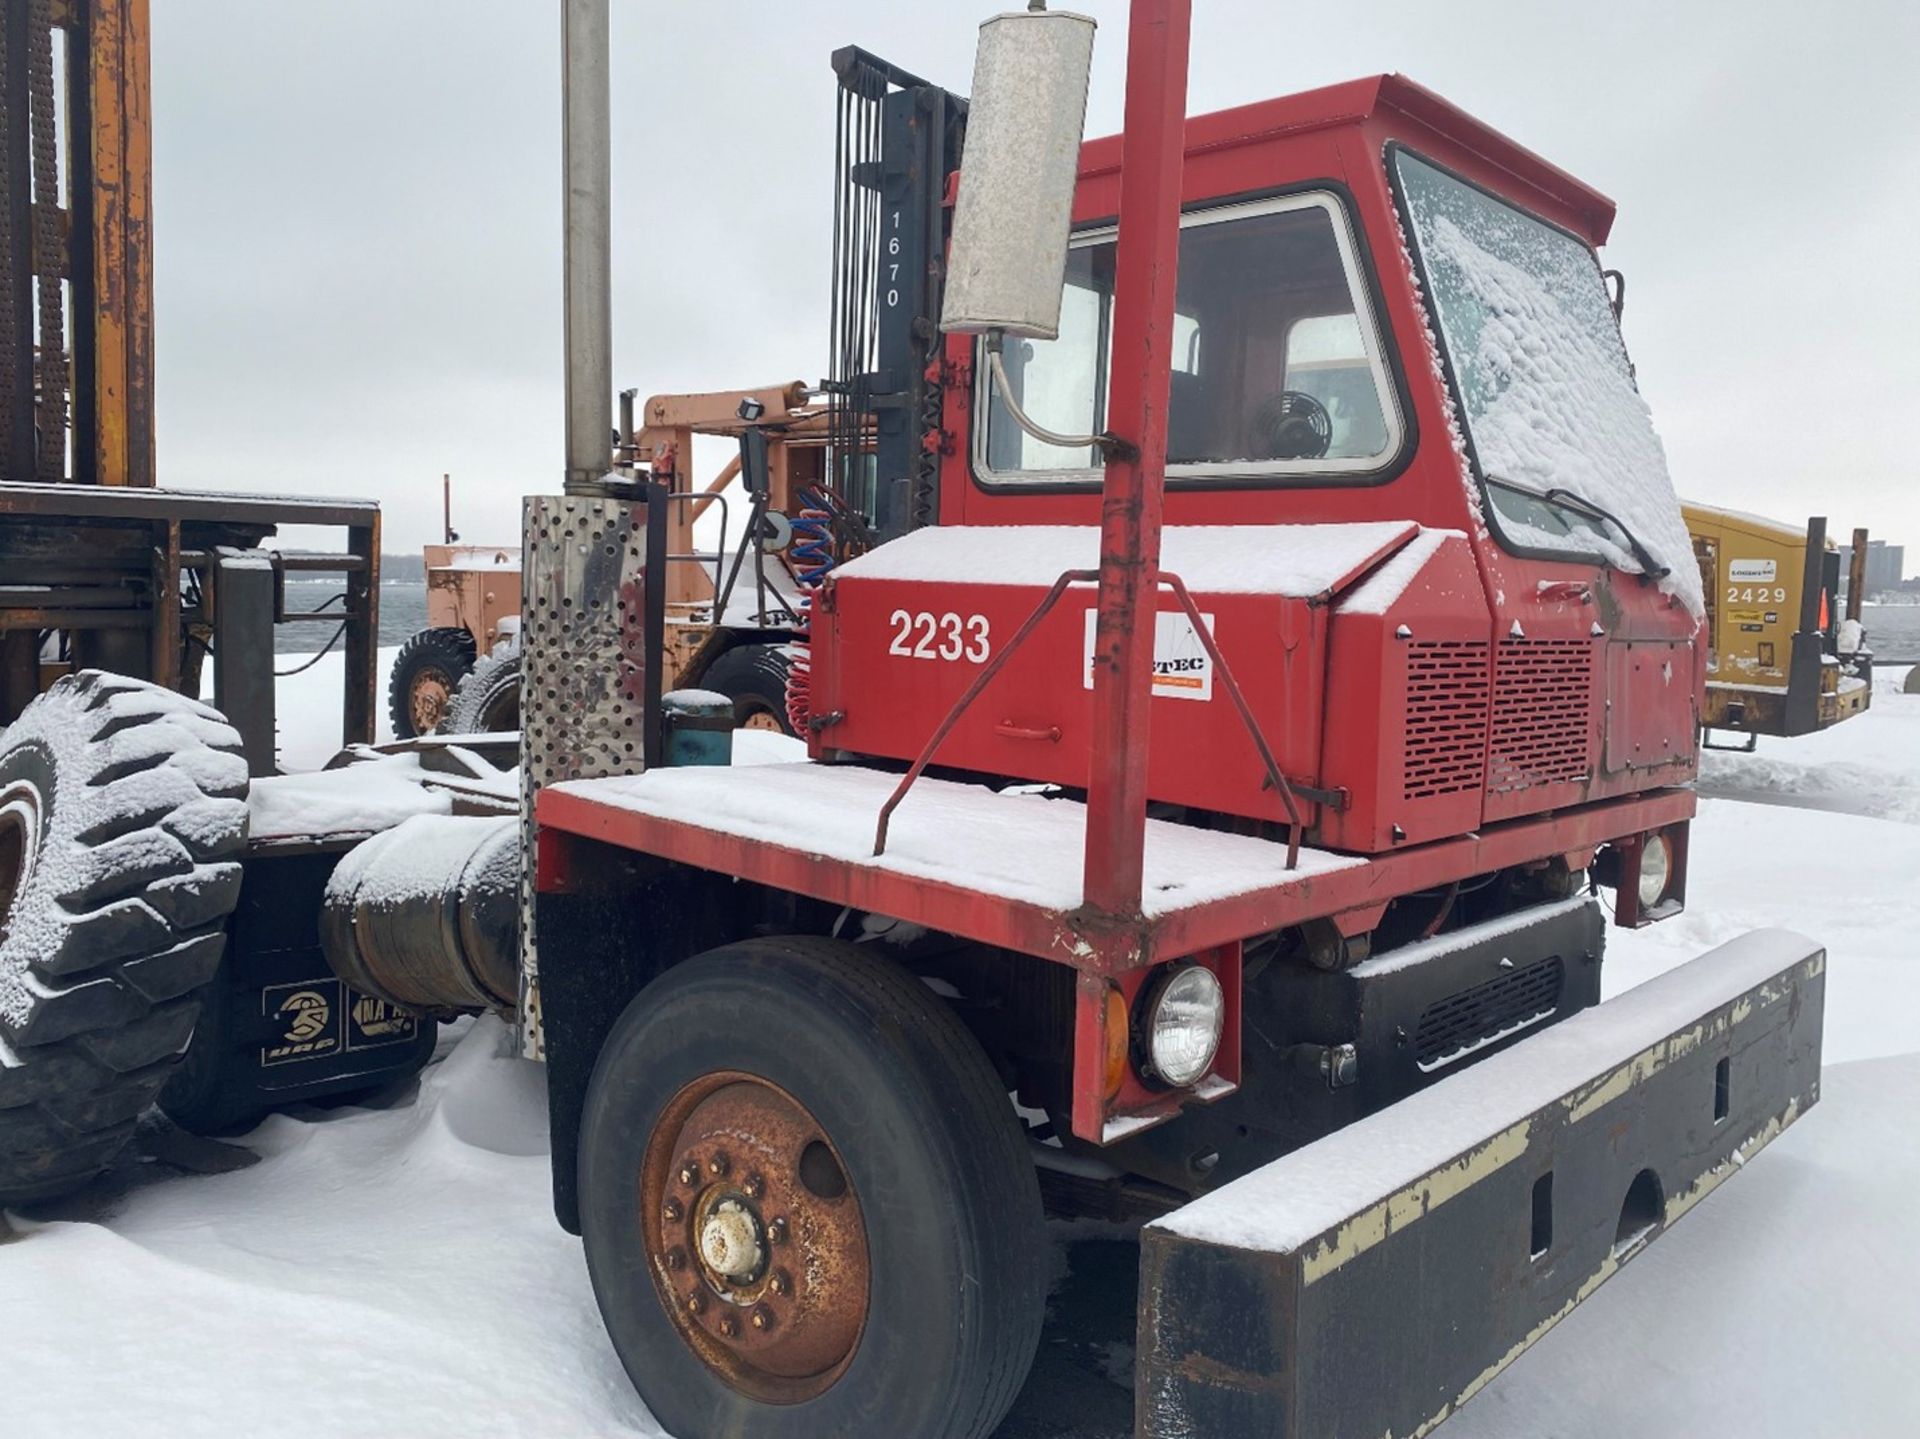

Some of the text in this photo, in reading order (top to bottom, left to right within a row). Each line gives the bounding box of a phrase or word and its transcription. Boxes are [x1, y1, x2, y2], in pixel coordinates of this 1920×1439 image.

[883, 212, 900, 306] 1670
[1727, 588, 1786, 603] 2429
[889, 609, 990, 663] 2233
